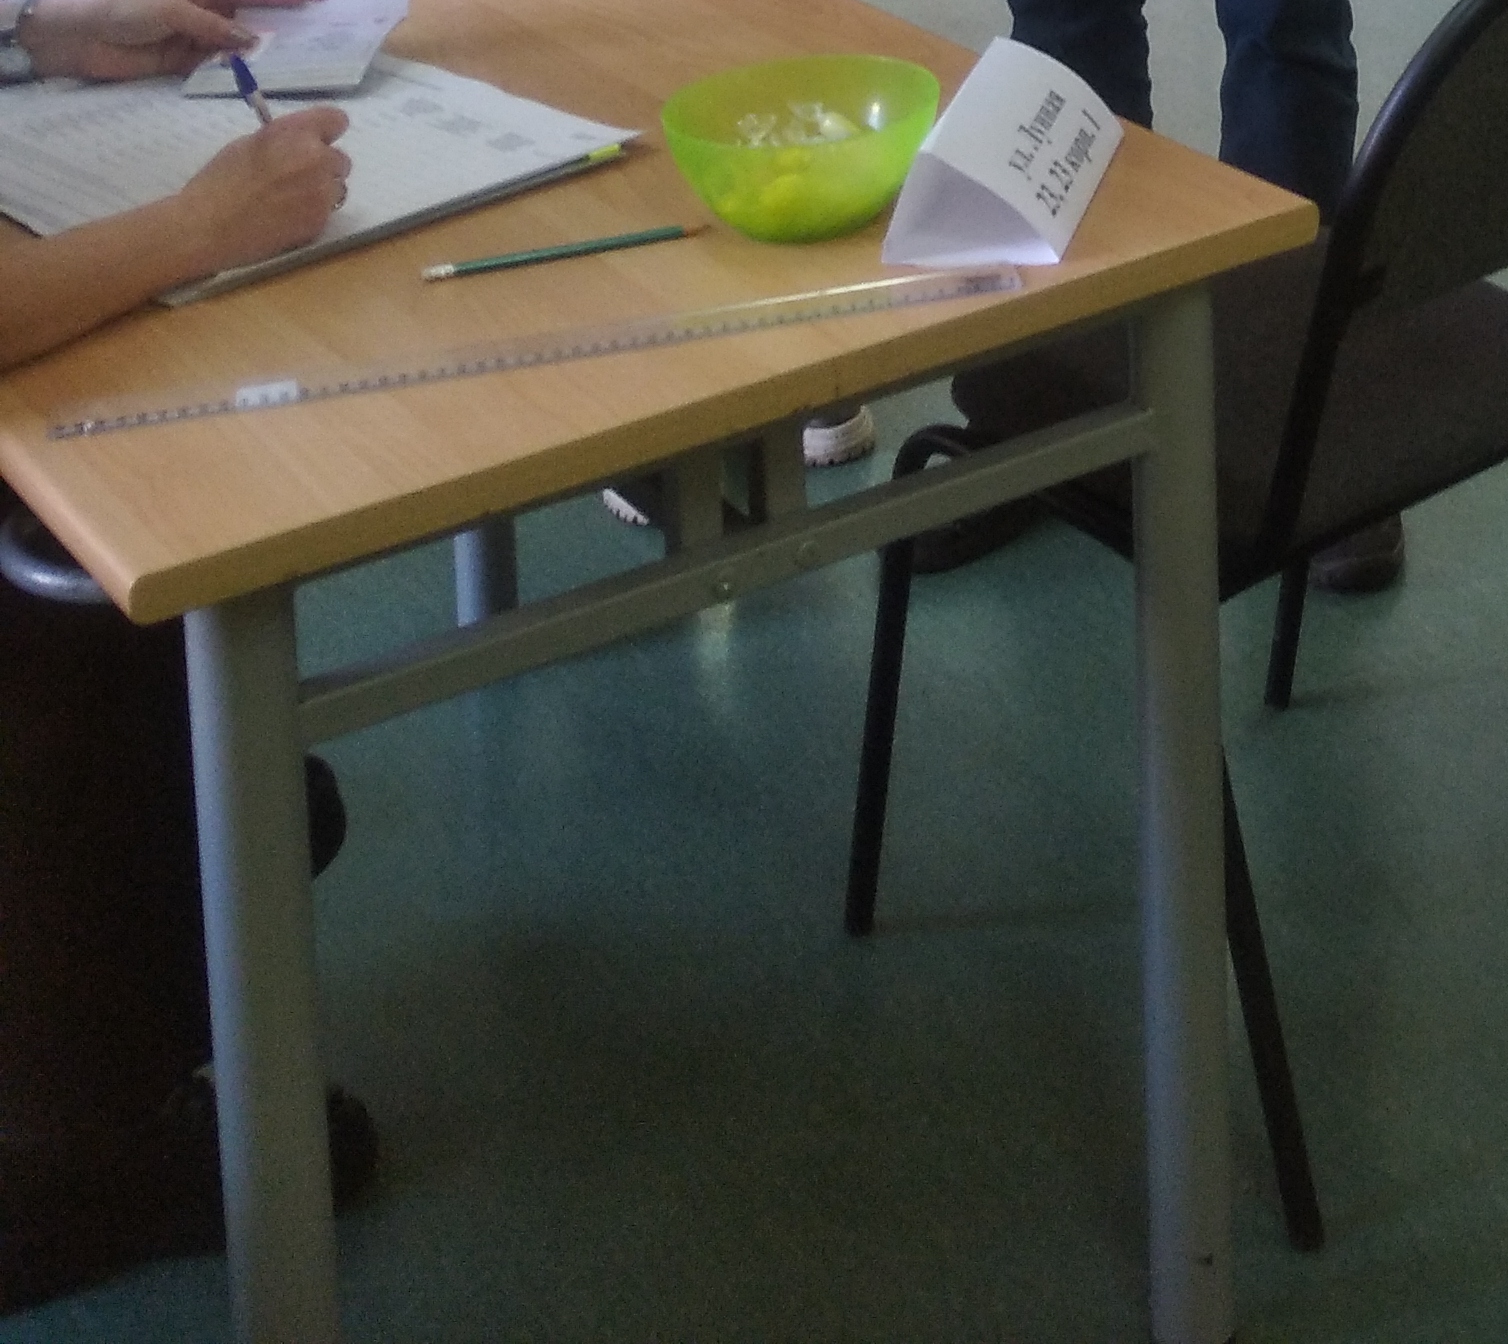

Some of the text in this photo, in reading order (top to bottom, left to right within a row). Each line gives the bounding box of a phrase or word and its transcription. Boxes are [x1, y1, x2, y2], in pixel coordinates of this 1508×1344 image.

[1008, 90, 1066, 181] ул. Лунная
[1064, 128, 1097, 173] корп.
[1049, 160, 1074, 193] 23
[1035, 184, 1064, 218] 23,
